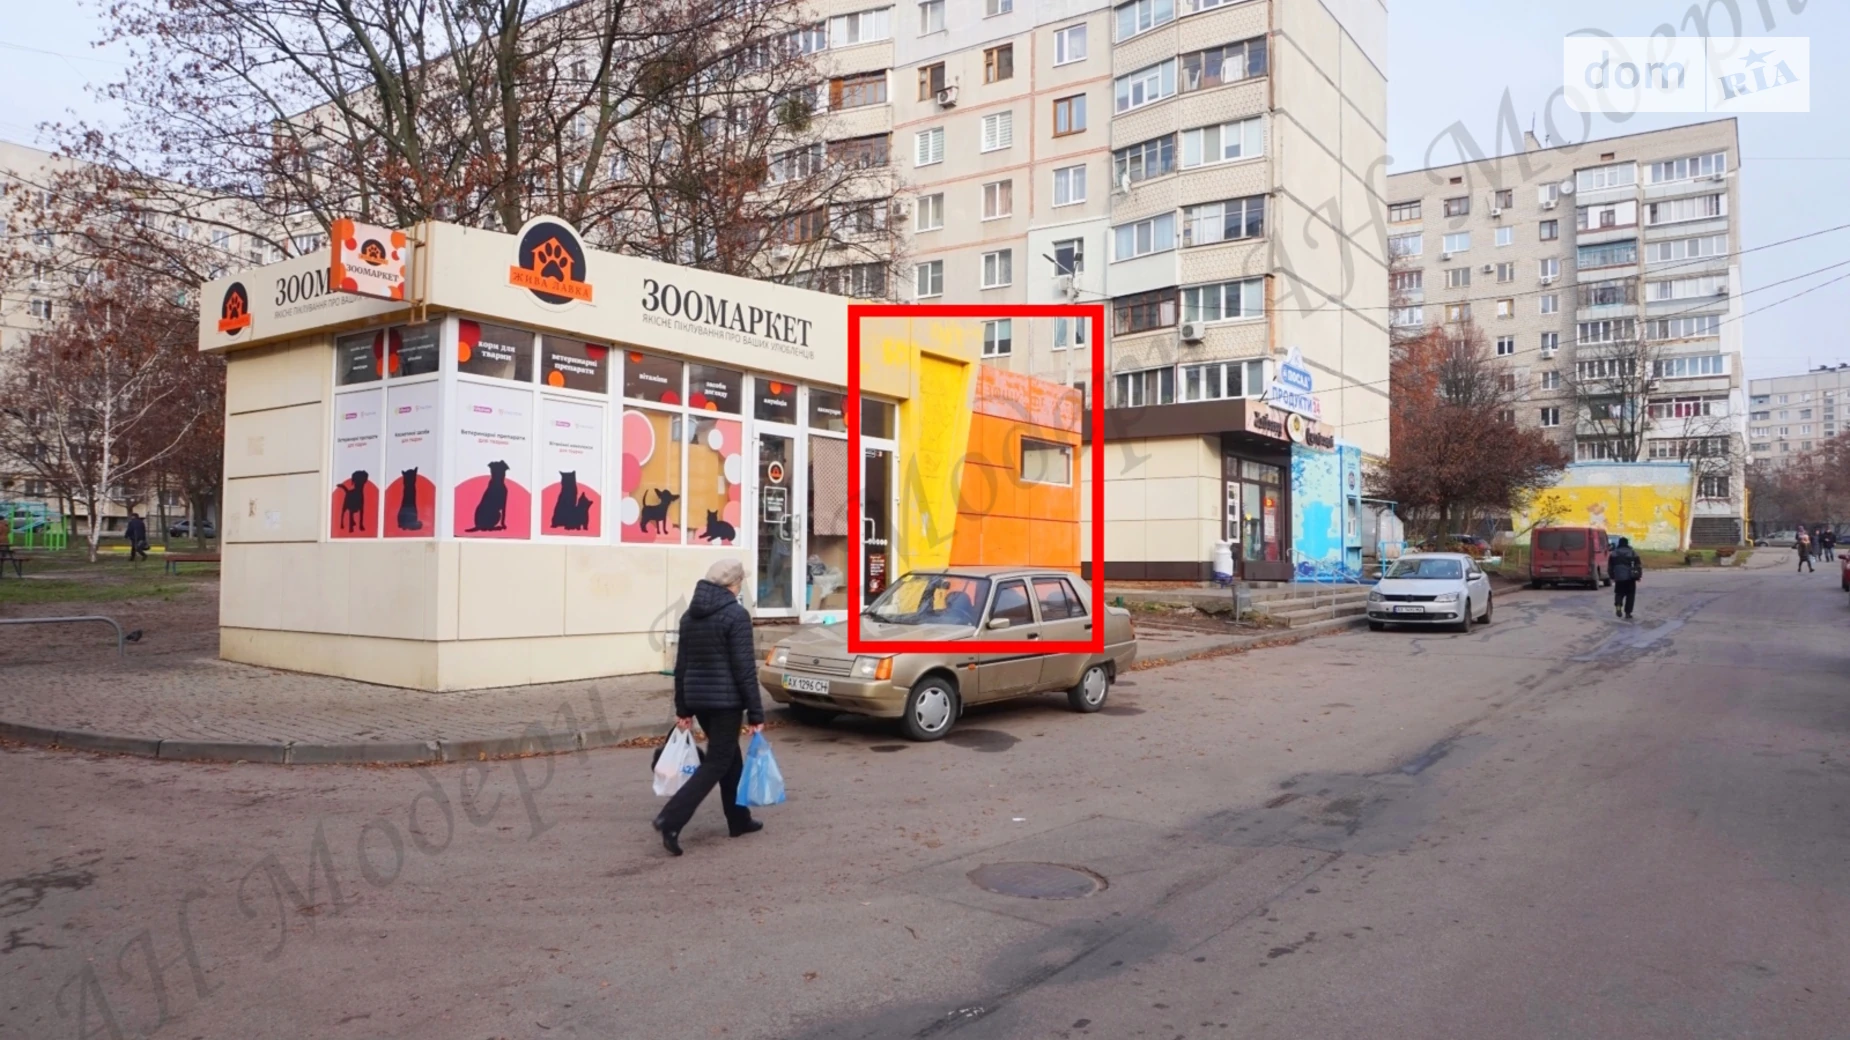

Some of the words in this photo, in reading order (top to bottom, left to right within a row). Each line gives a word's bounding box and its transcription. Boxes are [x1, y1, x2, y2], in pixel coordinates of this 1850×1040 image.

[346, 263, 400, 282] ЗООМАРКЕТ
[512, 271, 548, 288] ЖИВА
[552, 282, 589, 298] ЛАВКА
[641, 278, 813, 347] ЗООМАРКЕТ
[642, 313, 672, 329] ЯКІСНЕ
[674, 317, 725, 341] ПІКЛУВАННЯ
[725, 331, 741, 344] ПРО
[743, 335, 770, 350] ВАШИХ
[771, 341, 815, 361] УЛЮБЛЕНЦІВ
[478, 341, 499, 353] корм
[501, 344, 515, 353] для
[481, 350, 512, 362] тварин
[552, 353, 597, 368] ветеринарні
[554, 362, 594, 375] препарати
[1272, 386, 1312, 413] ПРОДУКТИ
